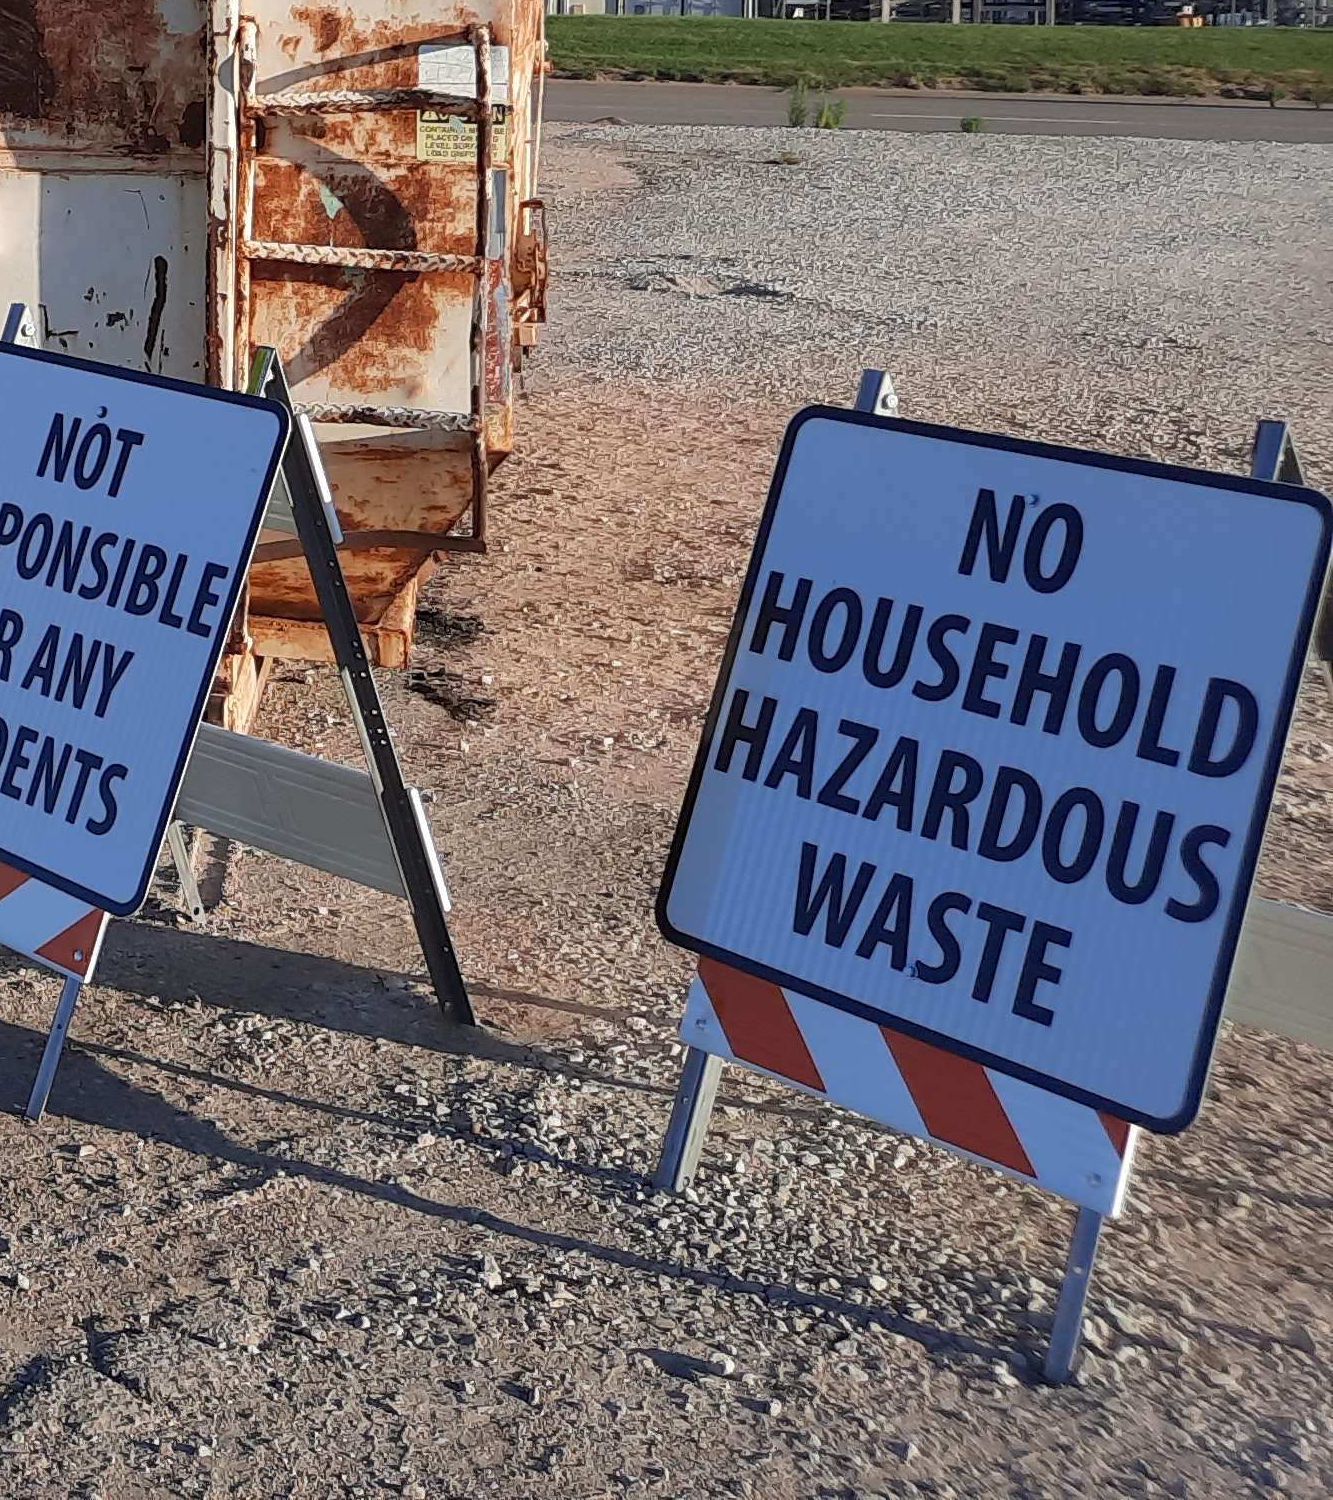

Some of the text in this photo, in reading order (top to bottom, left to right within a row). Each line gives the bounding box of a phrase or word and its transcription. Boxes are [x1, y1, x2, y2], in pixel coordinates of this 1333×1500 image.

[36, 412, 145, 498] NOT
[958, 488, 1084, 594] NO
[20, 624, 134, 718] ANY
[749, 570, 1260, 778] HOUSEHOLD
[714, 688, 1231, 924] HAZARDOUS
[792, 842, 1073, 1028] WASTE
